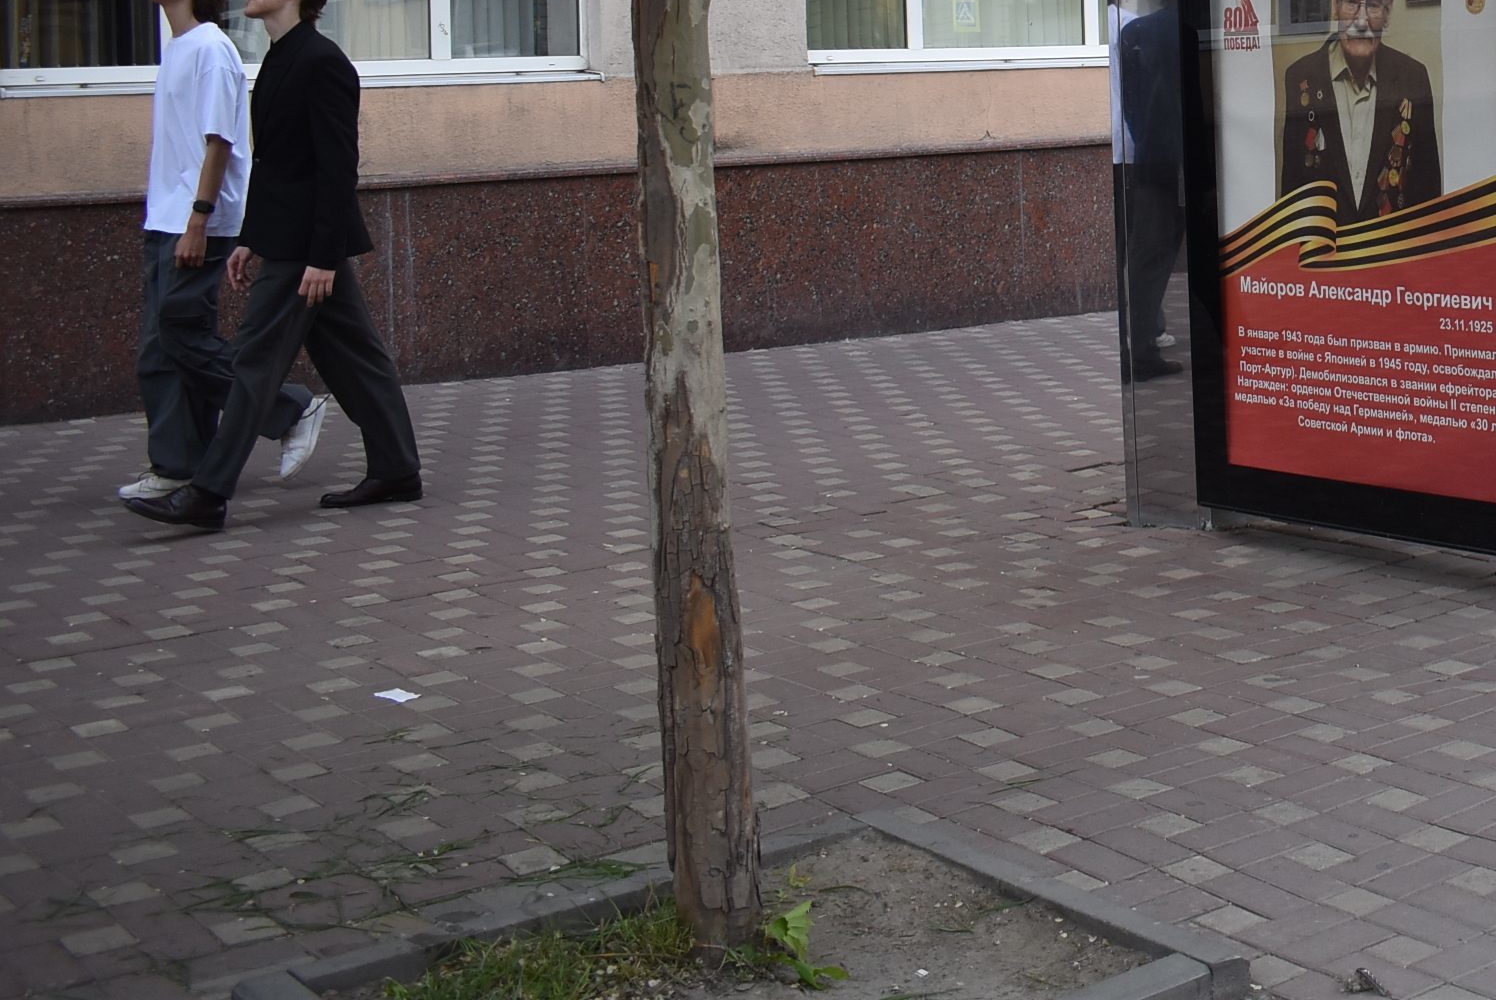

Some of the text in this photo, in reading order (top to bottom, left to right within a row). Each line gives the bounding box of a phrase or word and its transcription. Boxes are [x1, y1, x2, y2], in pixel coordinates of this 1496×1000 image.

[1224, 7, 1242, 32] 80
[1224, 36, 1261, 52] ПОБЕДА!
[1240, 276, 1493, 311] Майоров Александр Георгиевич
[1238, 326, 1245, 336] В
[1248, 330, 1279, 342] январе
[1282, 330, 1301, 342] 1943
[1305, 335, 1324, 345] года
[1328, 334, 1347, 346] был
[1351, 338, 1391, 351] призван
[1395, 342, 1400, 351] в
[1404, 344, 1441, 355] армию.
[1440, 318, 1493, 333] 23.11.1925
[1240, 361, 1297, 379] Порт-Артур).
[1299, 367, 1388, 387] Демобилизовался
[1391, 378, 1397, 387] в
[1400, 380, 1437, 392] звании
[1241, 346, 1496, 380] участие в войне с Японией в 1945 году, освобождал
[1238, 376, 1288, 391] Награжден:
[1291, 384, 1331, 397] орденом
[1334, 387, 1410, 405] Отечественной
[1414, 397, 1447, 409] войны
[1235, 392, 1276, 405] медалью
[1280, 396, 1294, 407] «За
[1297, 399, 1330, 414] победу
[1333, 404, 1351, 415] над
[1354, 404, 1416, 424] Германией»,
[1420, 414, 1467, 428] медалью
[1471, 419, 1488, 431] «30
[1298, 416, 1435, 443] Советской Армии и флота».
